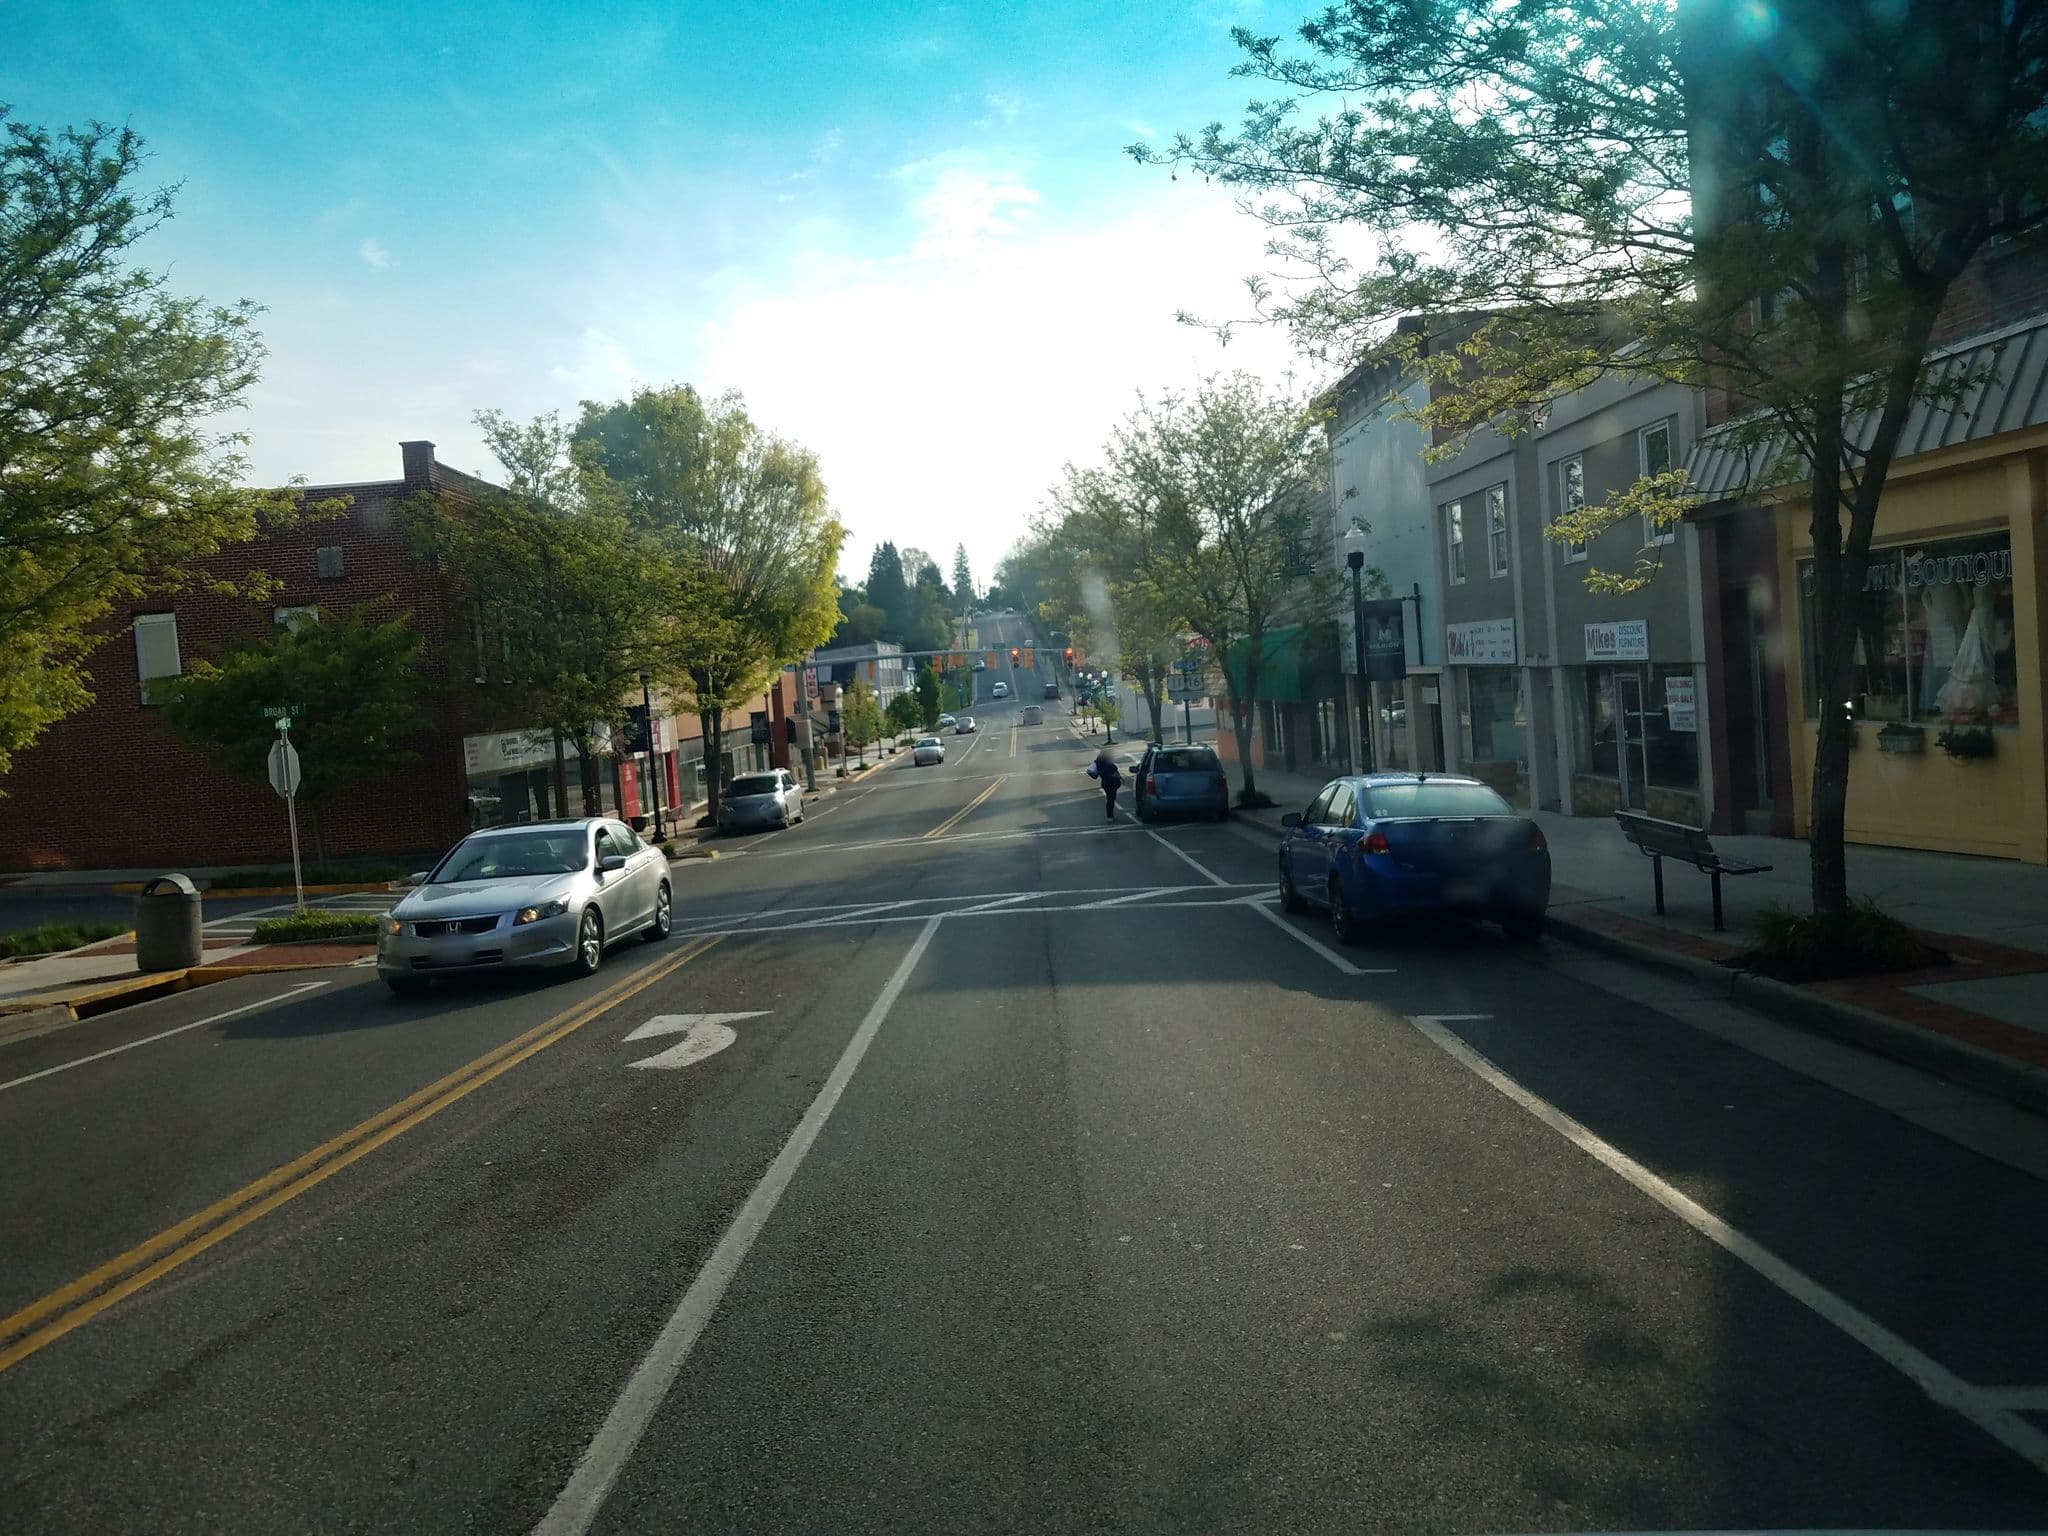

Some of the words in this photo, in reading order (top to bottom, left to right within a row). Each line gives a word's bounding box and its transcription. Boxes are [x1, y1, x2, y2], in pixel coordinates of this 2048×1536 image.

[1619, 624, 1645, 635] DISCOUNT
[1586, 628, 1617, 649] Mike's
[1619, 637, 1646, 648] FURNITURE
[1172, 677, 1181, 688] 11
[1188, 676, 1200, 687] 16
[264, 707, 287, 717] BROAD
[291, 705, 299, 715] ST
